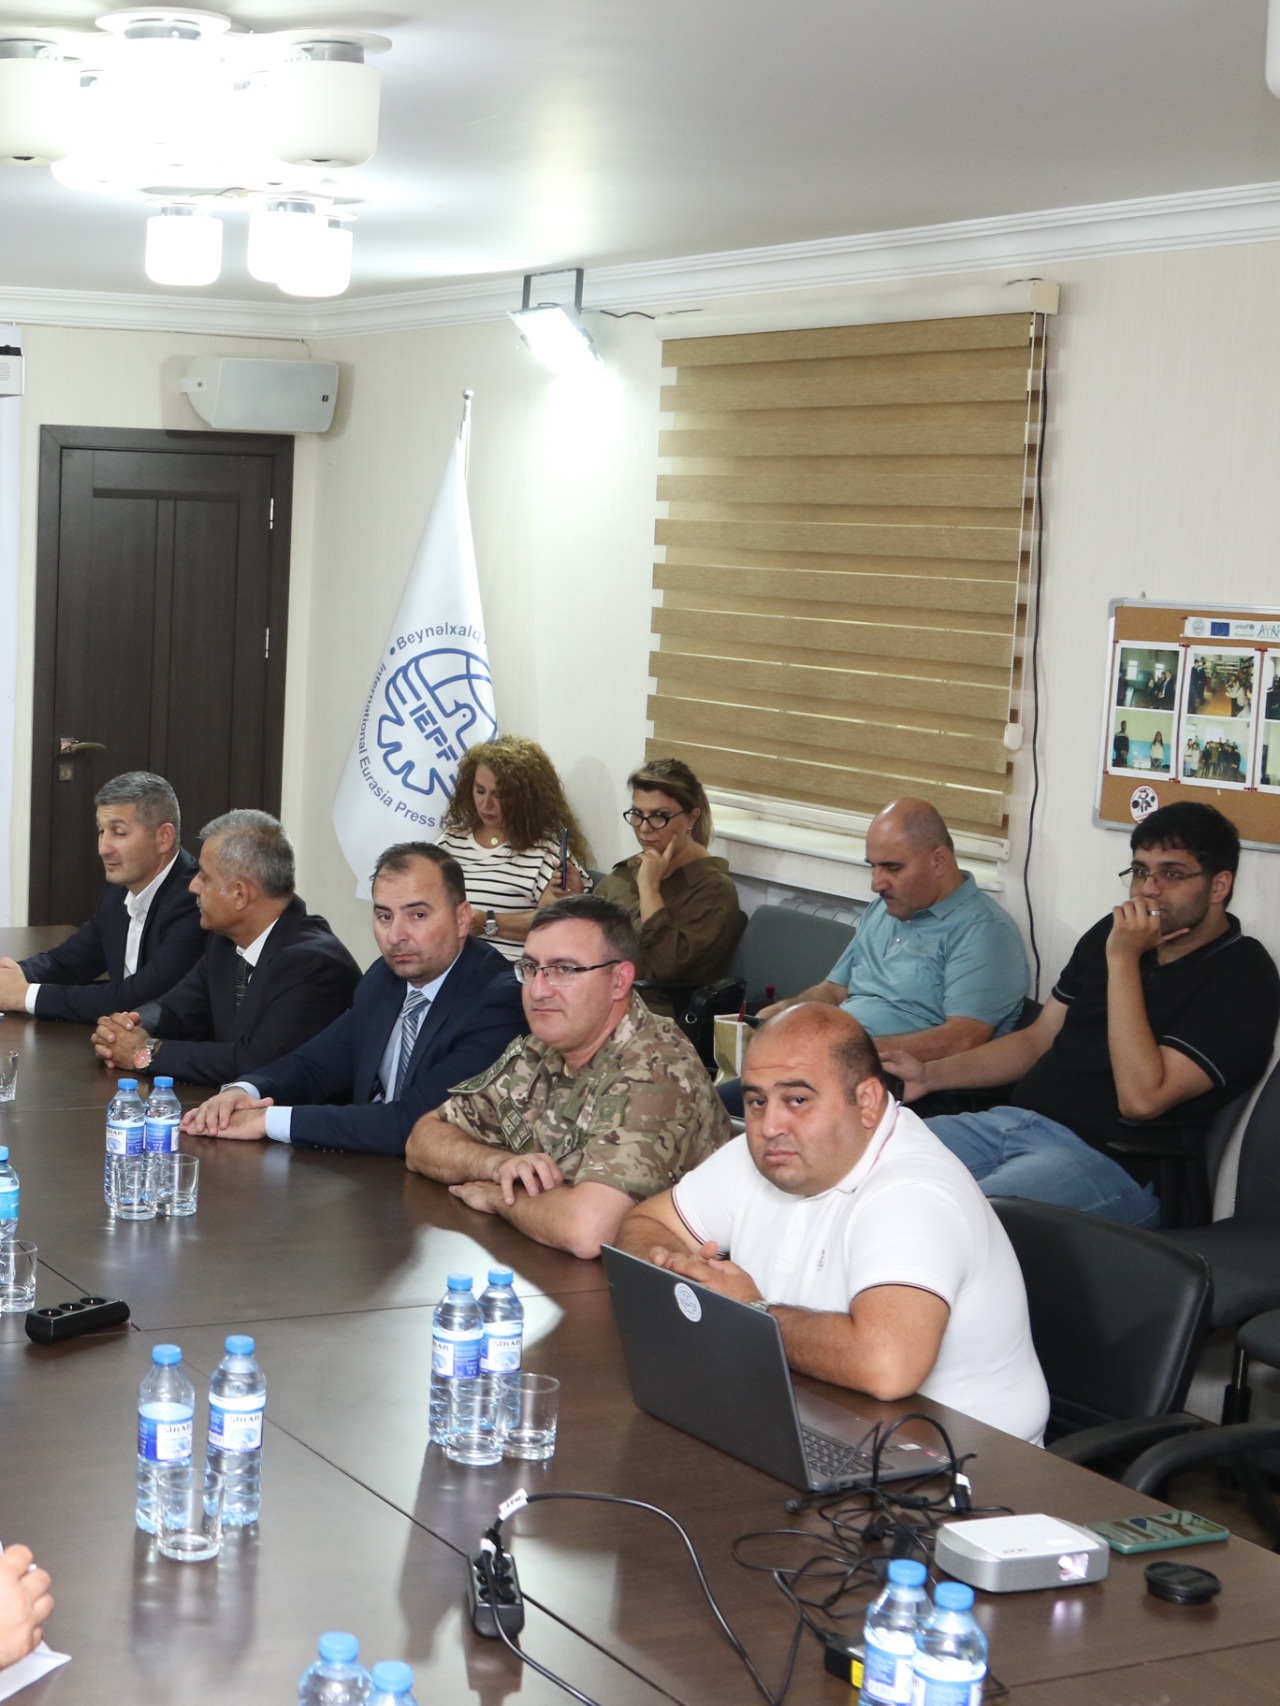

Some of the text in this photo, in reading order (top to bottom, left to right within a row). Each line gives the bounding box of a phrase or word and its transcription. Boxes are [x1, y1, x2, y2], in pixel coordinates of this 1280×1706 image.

[409, 702, 459, 762] IEPF
[359, 756, 394, 807] Eurasia
[394, 801, 436, 828] Press
